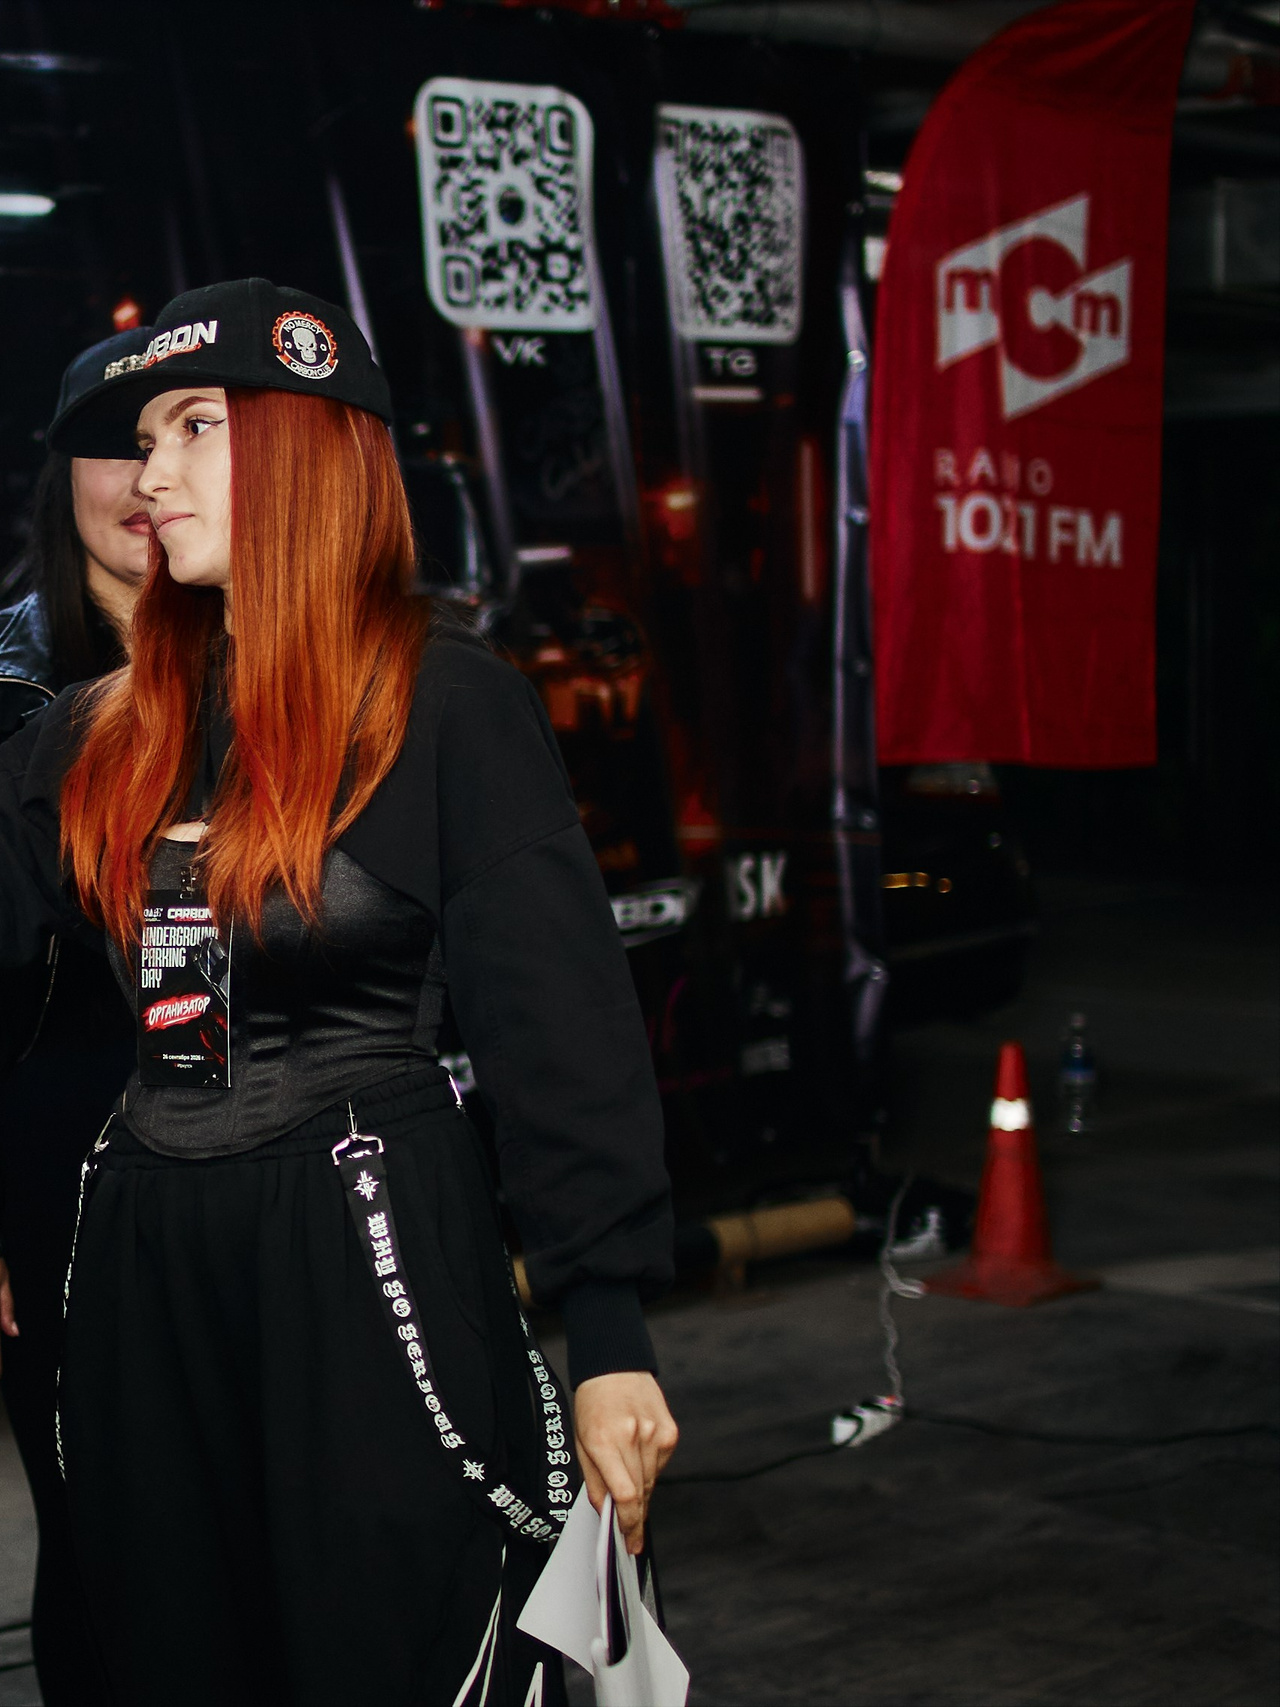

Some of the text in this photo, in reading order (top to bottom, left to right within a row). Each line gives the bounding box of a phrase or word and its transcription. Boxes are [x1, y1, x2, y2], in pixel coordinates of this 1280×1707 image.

[282, 319, 322, 335] NO MERCY
[492, 338, 546, 366] VK
[704, 347, 756, 375] TG
[1048, 504, 1125, 570] FM
[141, 947, 186, 967] PARKING
[141, 968, 163, 989] DAY
[148, 996, 211, 1026] ОРГАНИЗАТОР
[382, 1280, 412, 1318] SO
